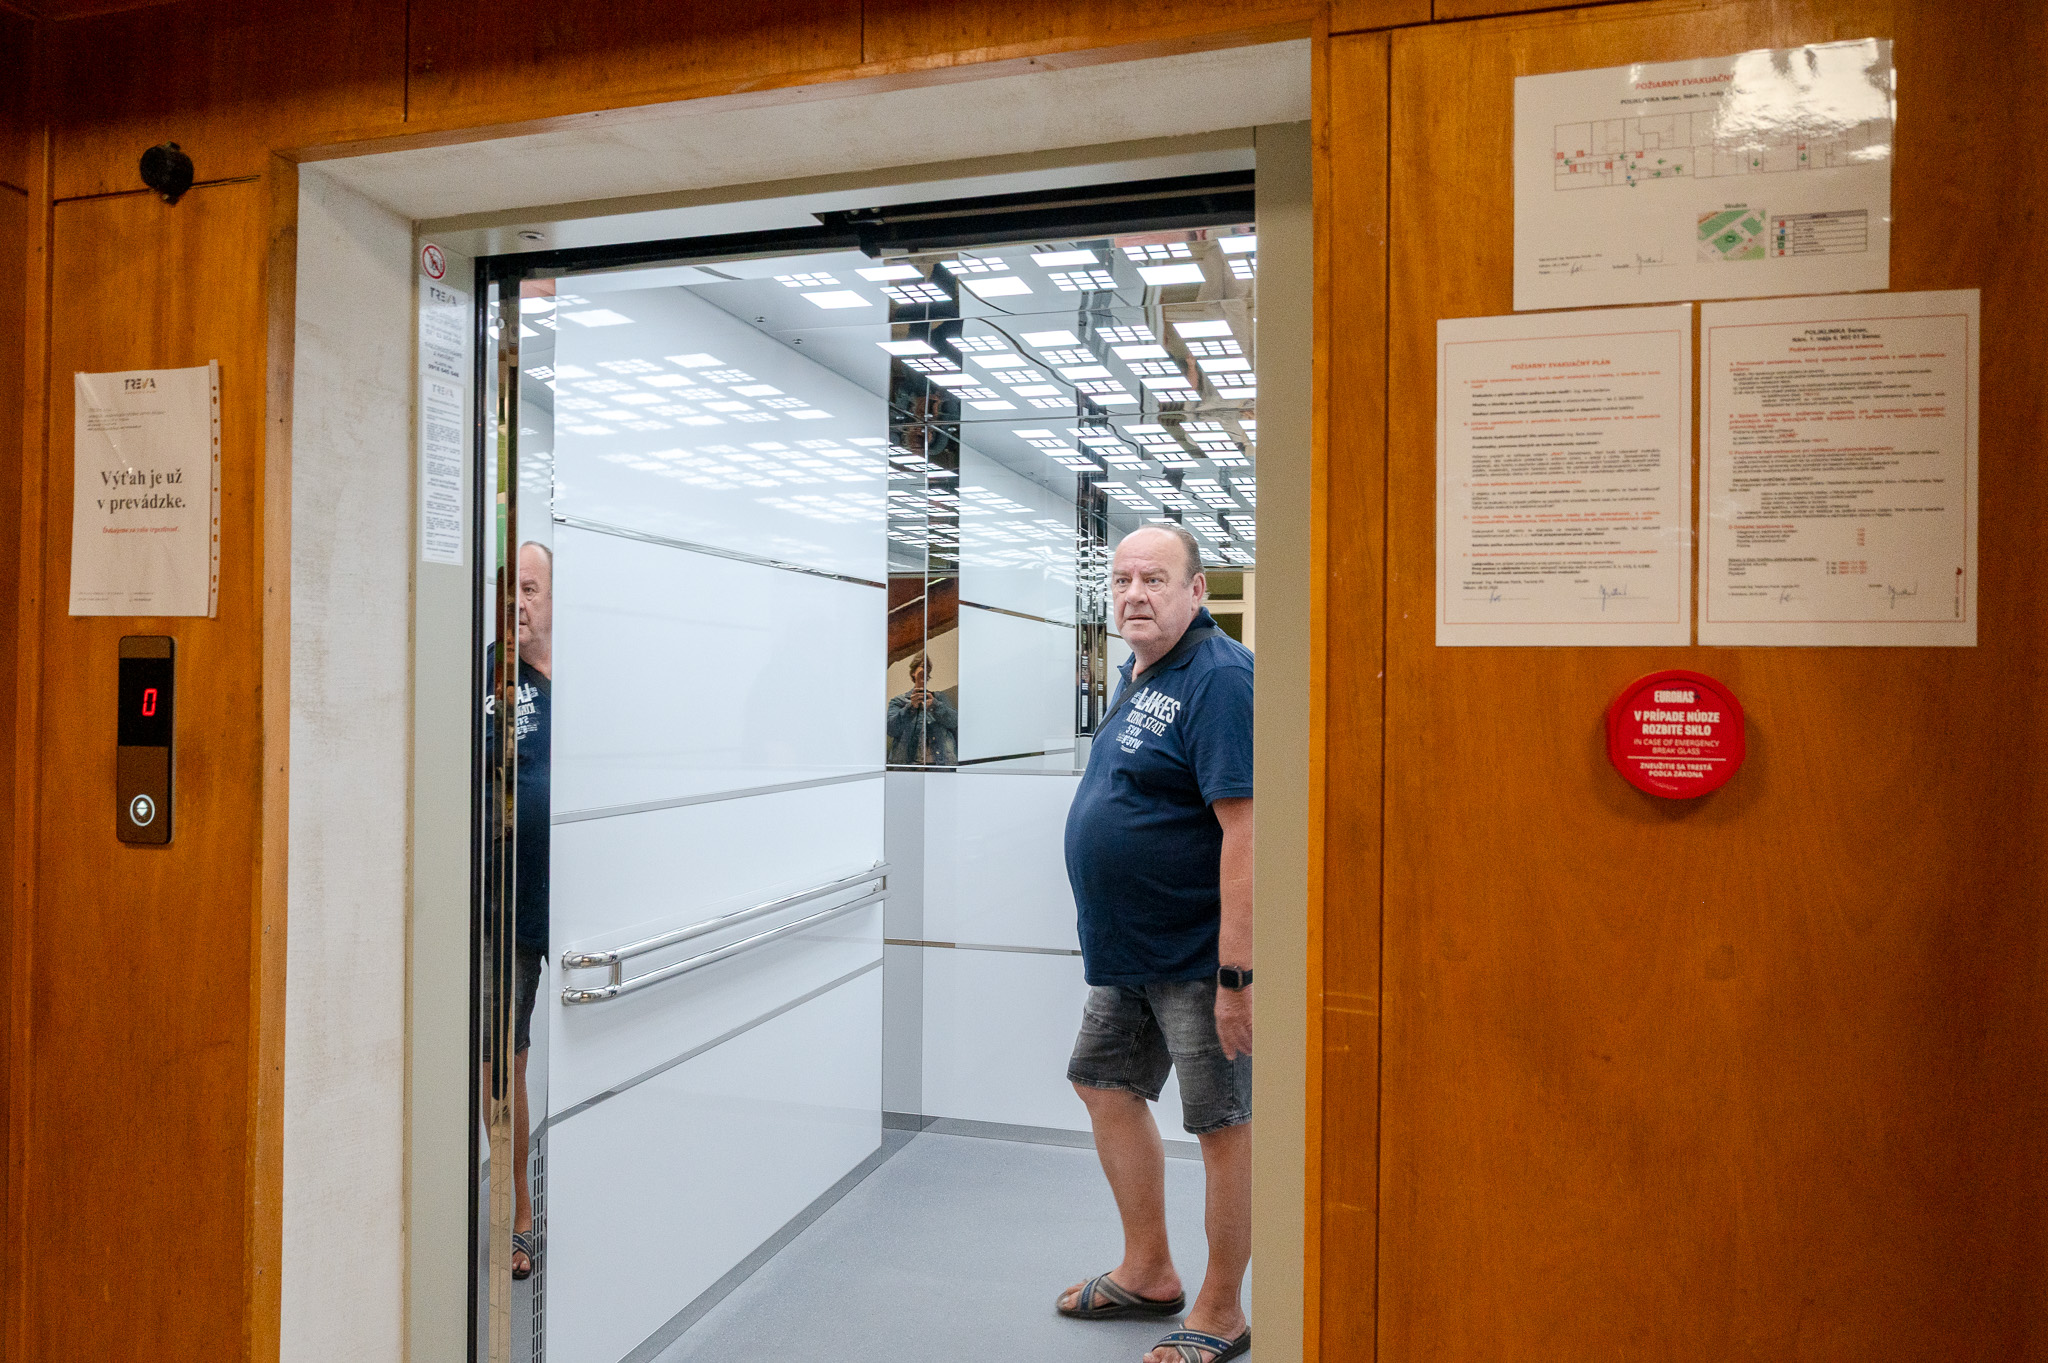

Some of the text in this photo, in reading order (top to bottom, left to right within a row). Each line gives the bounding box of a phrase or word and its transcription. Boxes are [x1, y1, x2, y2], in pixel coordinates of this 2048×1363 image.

[100, 467, 183, 490] Výťah je už
[96, 493, 186, 514] v prevádzke.
[142, 688, 157, 716] 0
[1135, 686, 1181, 724] LAKES
[1633, 708, 1720, 723] V PRÍPADE NÚDZE
[1143, 716, 1168, 737] STATE
[1642, 723, 1712, 736] ROZBITE SKLO
[1643, 738, 1661, 746] CASE
[1674, 739, 1720, 747] EMERGENCY
[1652, 747, 1700, 755] BREAK GLASS
[1639, 762, 1713, 771] ZNEUŽITIE SA TRESTÁ
[1673, 770, 1704, 779] ZÁKONA
